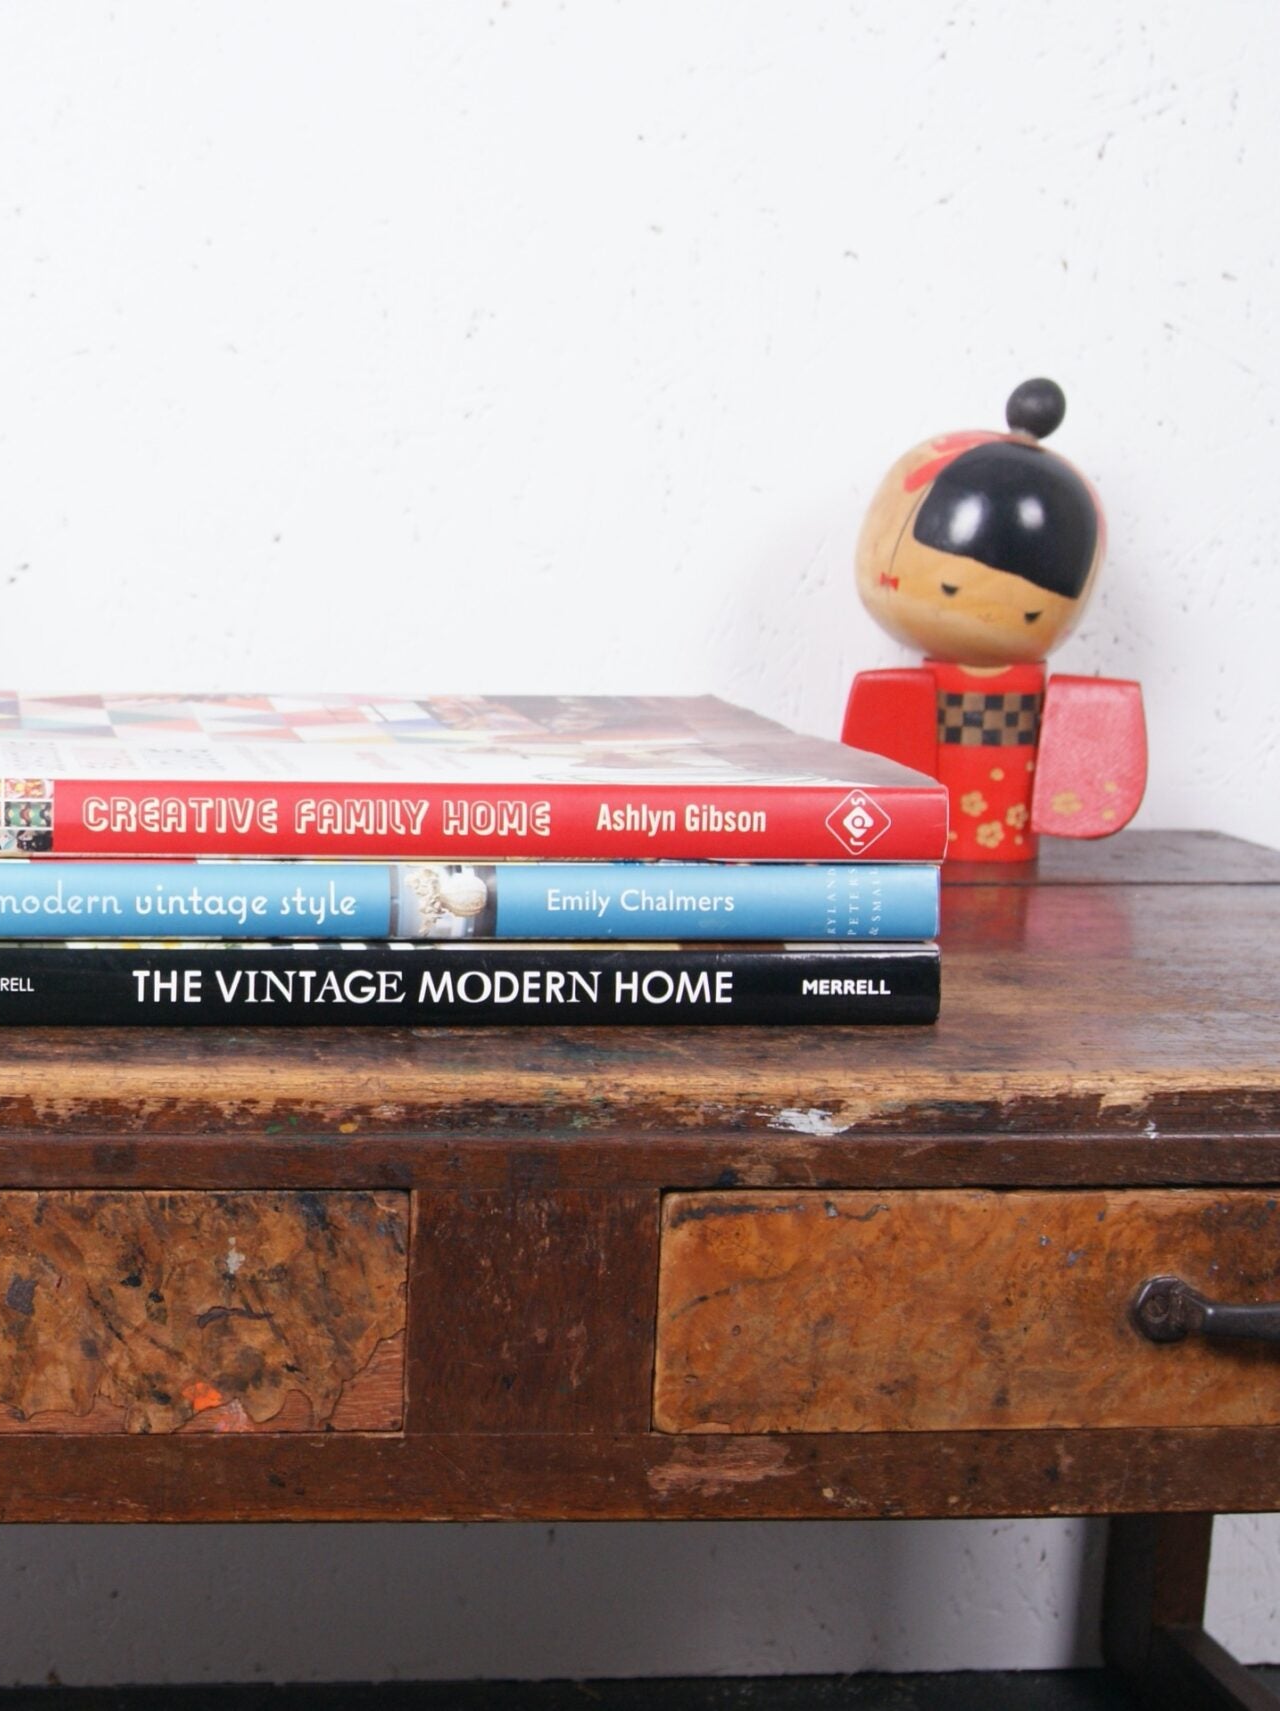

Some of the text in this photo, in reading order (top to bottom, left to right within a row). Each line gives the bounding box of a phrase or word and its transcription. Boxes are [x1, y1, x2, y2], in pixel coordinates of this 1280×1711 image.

[82, 796, 552, 836] CREATIVE FAMILY HOME
[596, 803, 767, 837] Ashlyn Gibson
[135, 884, 267, 924] vintage
[279, 882, 357, 924] style
[546, 889, 735, 918] Emily Chalmers
[826, 868, 837, 935] RYLAND
[847, 868, 859, 936] PETERS
[132, 969, 734, 1004] THE VINTAGE MODERN HOME
[801, 979, 891, 996] MERRELL
